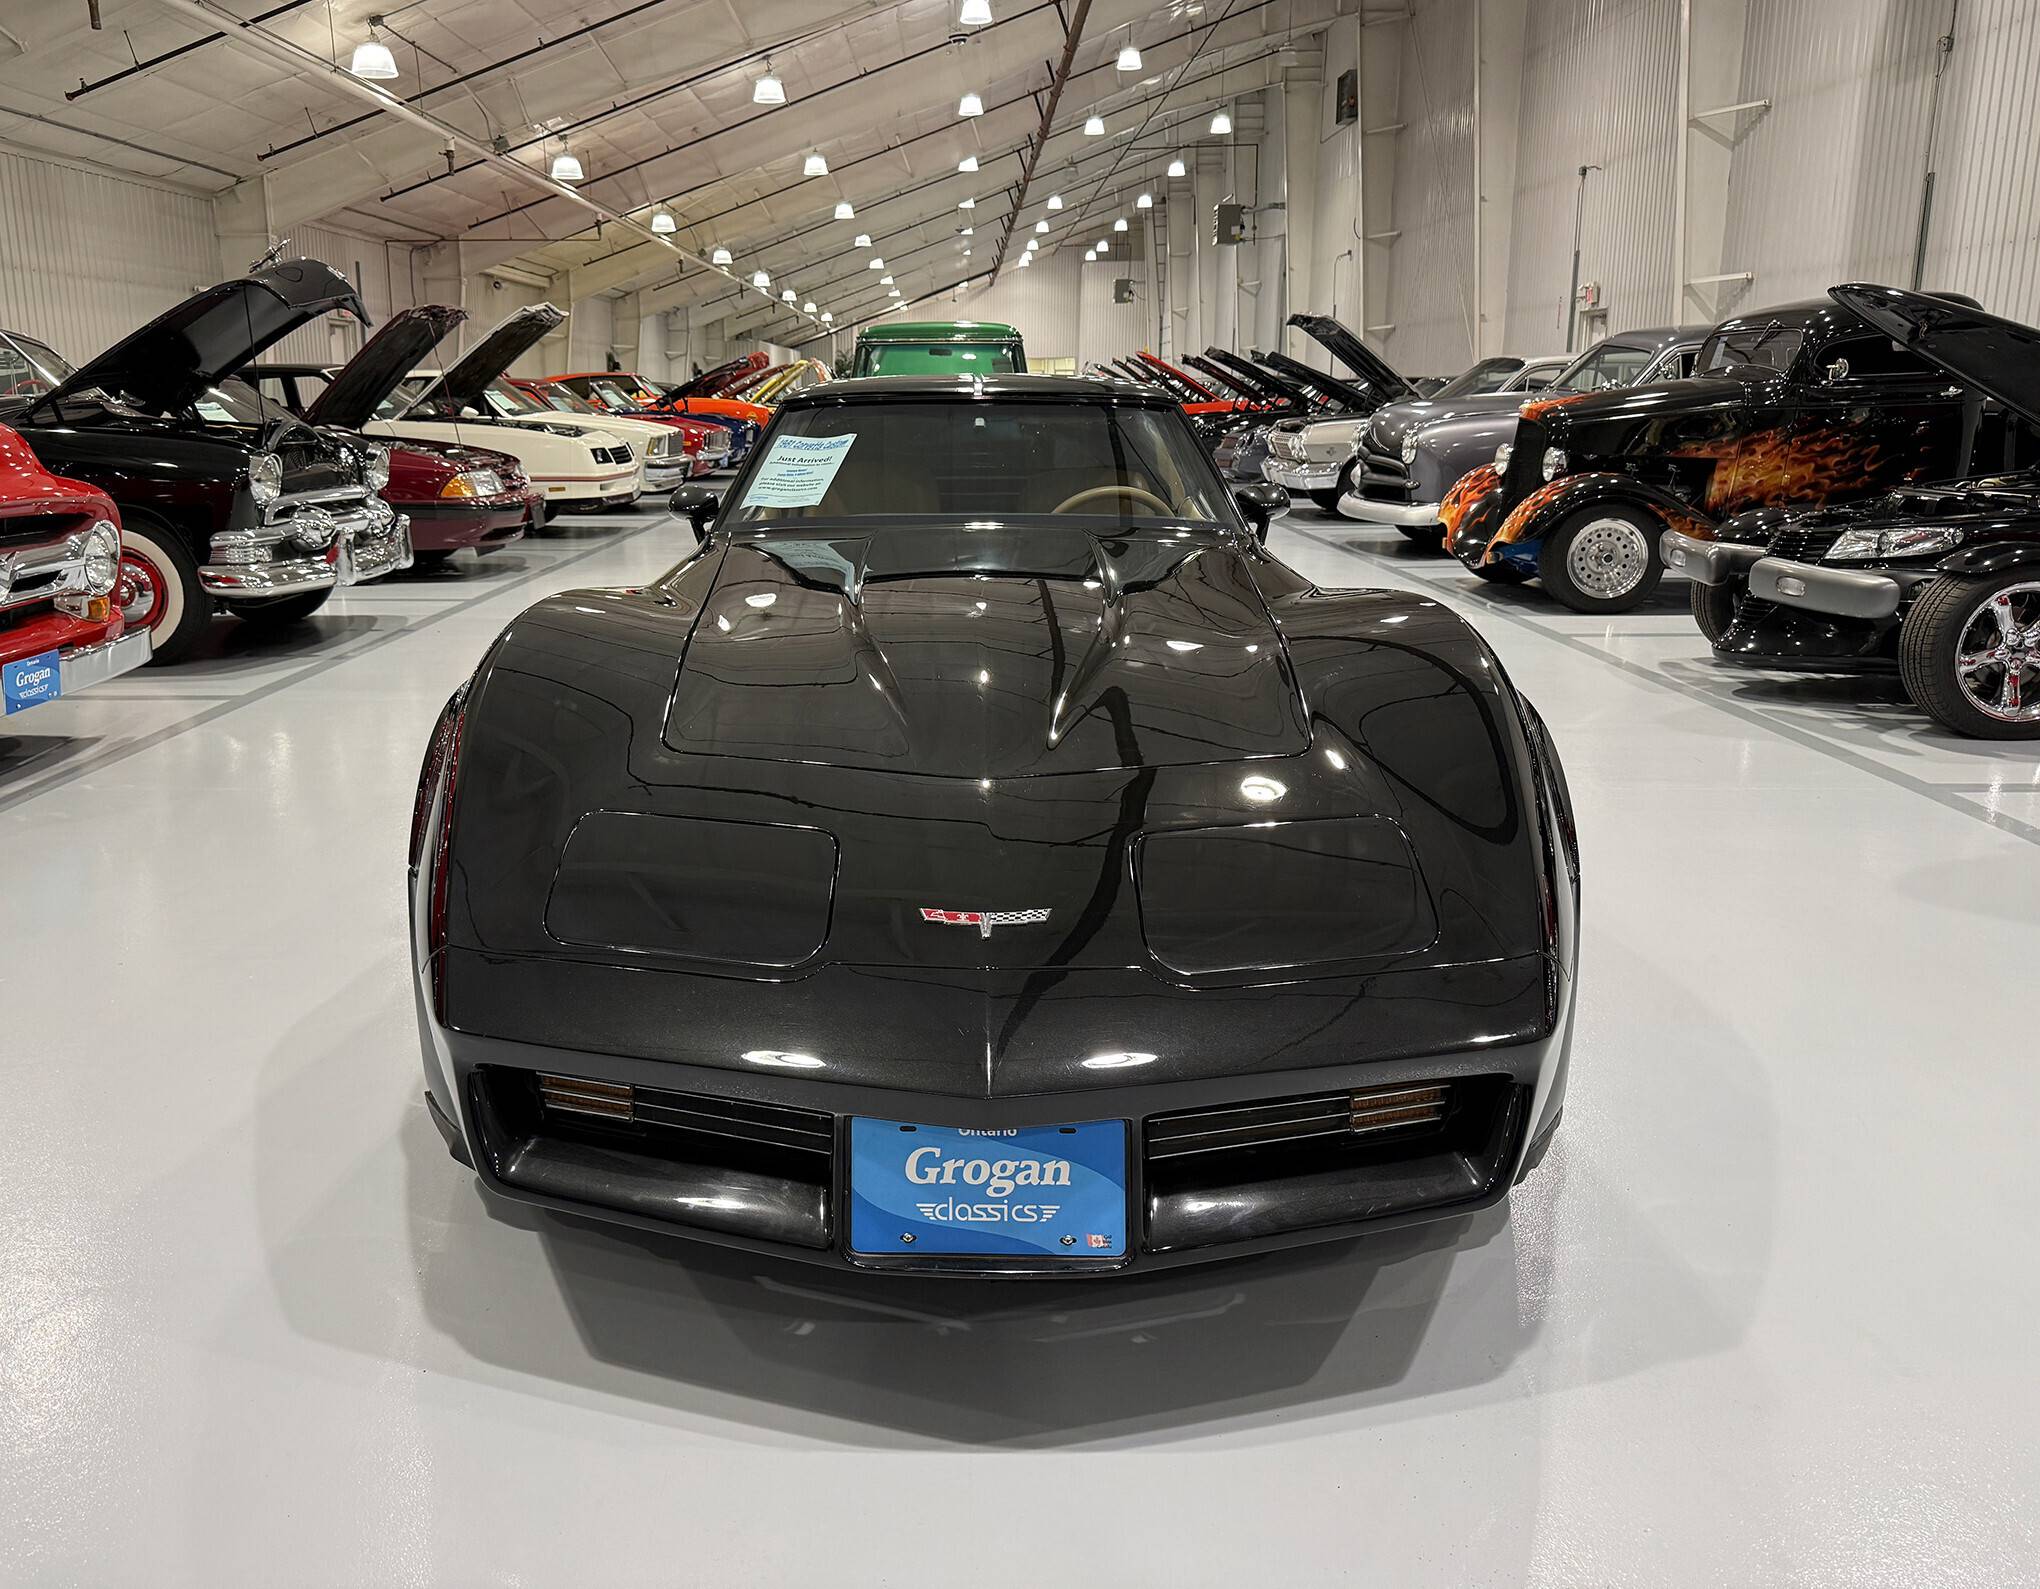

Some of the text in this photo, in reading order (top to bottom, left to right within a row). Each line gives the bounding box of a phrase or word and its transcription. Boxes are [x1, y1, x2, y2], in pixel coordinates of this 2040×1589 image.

[16, 667, 51, 687] Grogan
[904, 1147, 1071, 1198] Grogan
[934, 1197, 1038, 1223] classics
